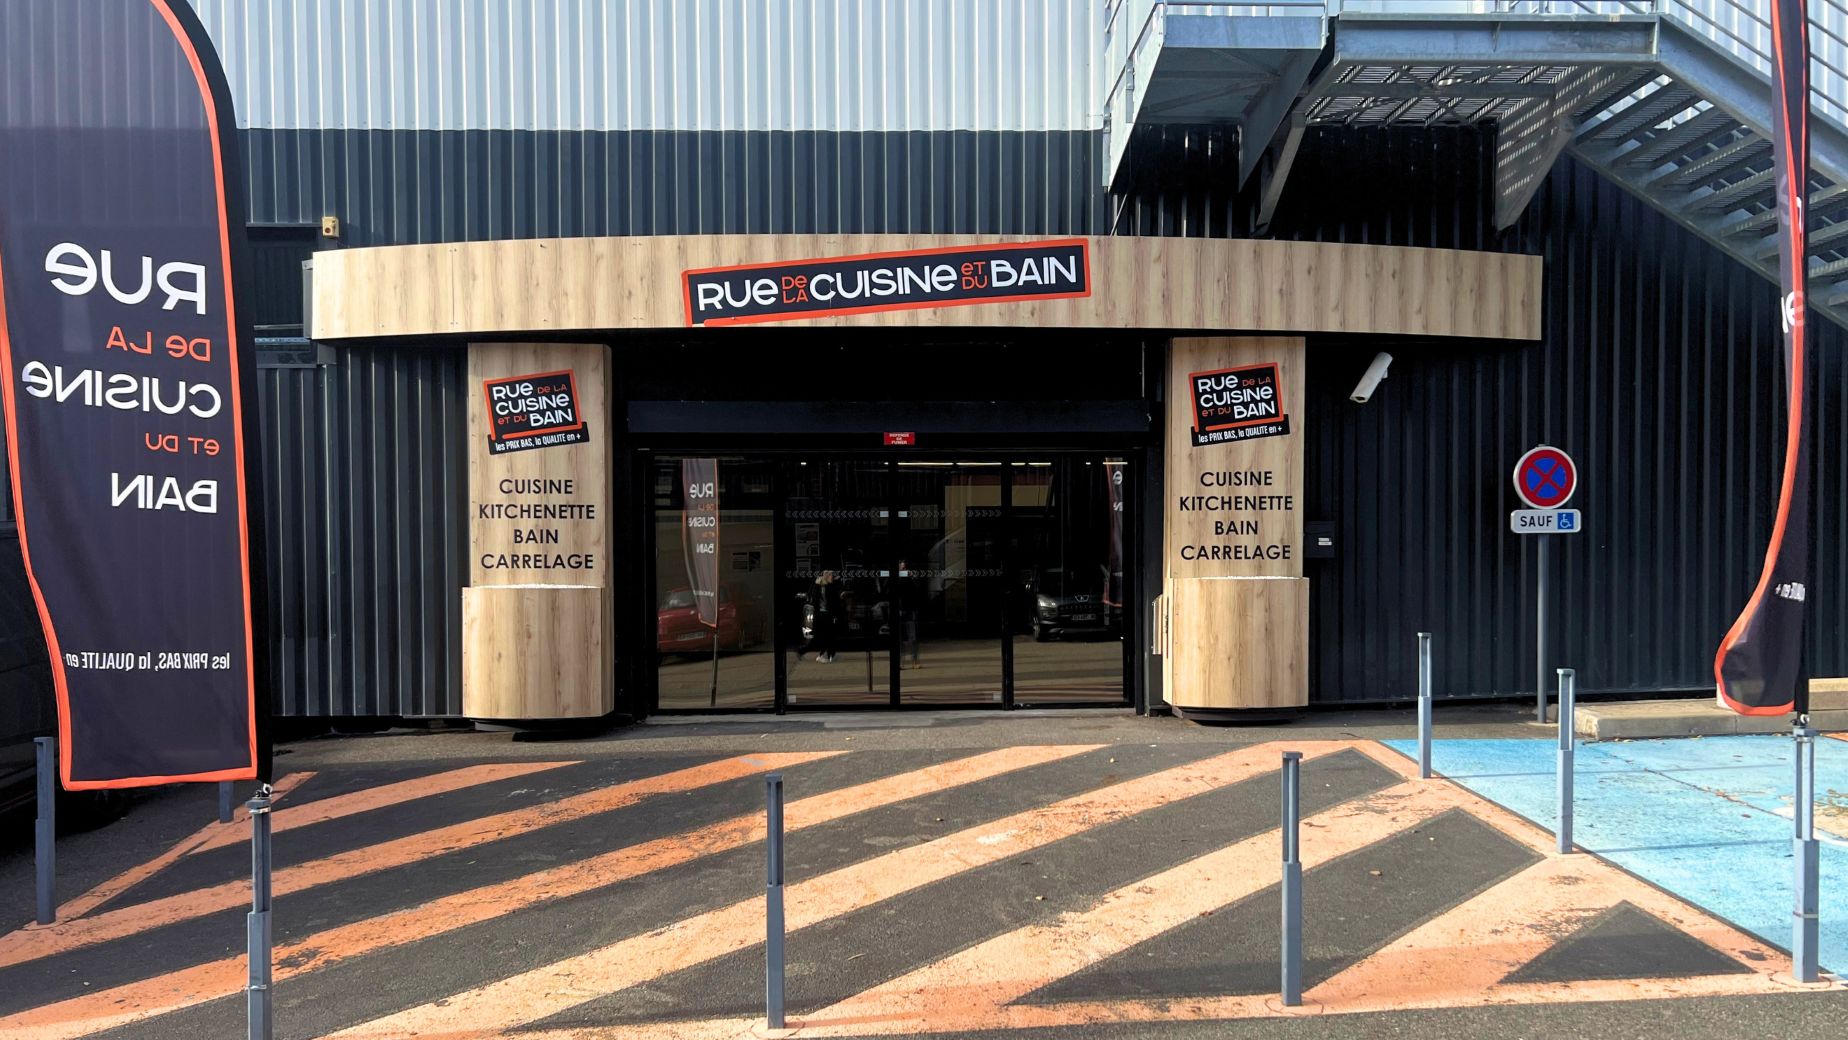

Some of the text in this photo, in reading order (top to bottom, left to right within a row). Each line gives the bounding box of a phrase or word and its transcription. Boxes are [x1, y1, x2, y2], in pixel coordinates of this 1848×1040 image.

[990, 255, 1077, 288] BAIN
[782, 275, 807, 289] De
[809, 264, 957, 301] CUISINe
[962, 276, 987, 290] DU
[697, 277, 778, 311] RUe
[783, 289, 809, 304] LA
[492, 382, 533, 400] RUe
[554, 384, 567, 392] LA
[1198, 375, 1238, 393] RUe
[1258, 376, 1271, 385] LA
[495, 393, 570, 415] CUISINe
[1200, 386, 1273, 408] CUISINe
[513, 414, 528, 423] DU
[529, 408, 573, 427] BAIN
[1218, 407, 1232, 415] DU
[1233, 401, 1275, 419] BAIN
[1198, 434, 1209, 443] les
[1209, 432, 1223, 442] PRIX
[1238, 429, 1245, 438] la
[1268, 425, 1277, 434] en
[495, 442, 506, 452] les
[506, 440, 521, 450] PRIX
[535, 437, 542, 445] la
[566, 433, 575, 441] en
[499, 479, 573, 494] CUISINE
[1200, 471, 1273, 487] CUISINE
[1179, 495, 1293, 511] KITCHENETTE
[479, 504, 595, 519] KITCHENETTE
[1214, 520, 1258, 535] BAIN
[1520, 515, 1552, 527] SAUF
[514, 529, 558, 544] BAIN
[1181, 544, 1291, 560] CARRELAGE
[481, 554, 593, 569] CARRELAGE
